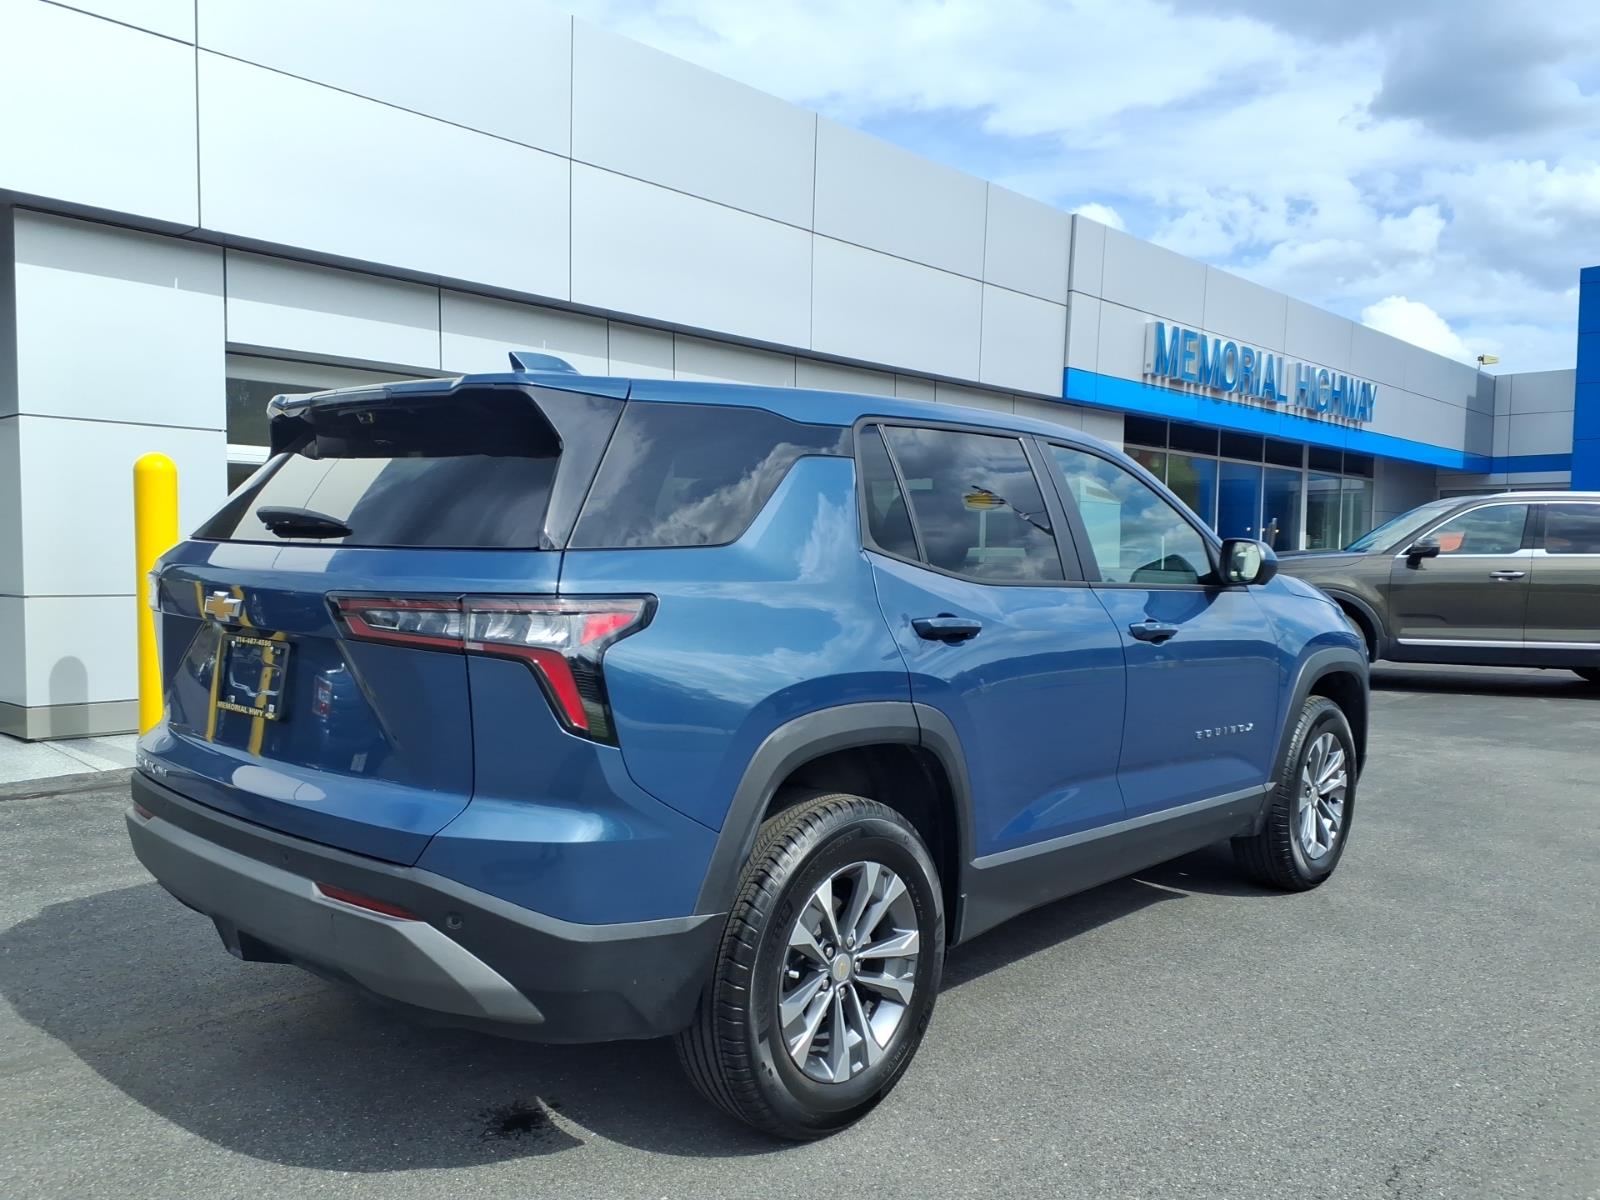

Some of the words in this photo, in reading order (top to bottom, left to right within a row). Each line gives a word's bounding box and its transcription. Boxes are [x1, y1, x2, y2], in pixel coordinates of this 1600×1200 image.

[1149, 321, 1288, 404] MEMORIAL
[1293, 362, 1378, 423] HIGHWAY
[217, 701, 248, 714] MEMORIAL
[248, 707, 264, 717] HWY
